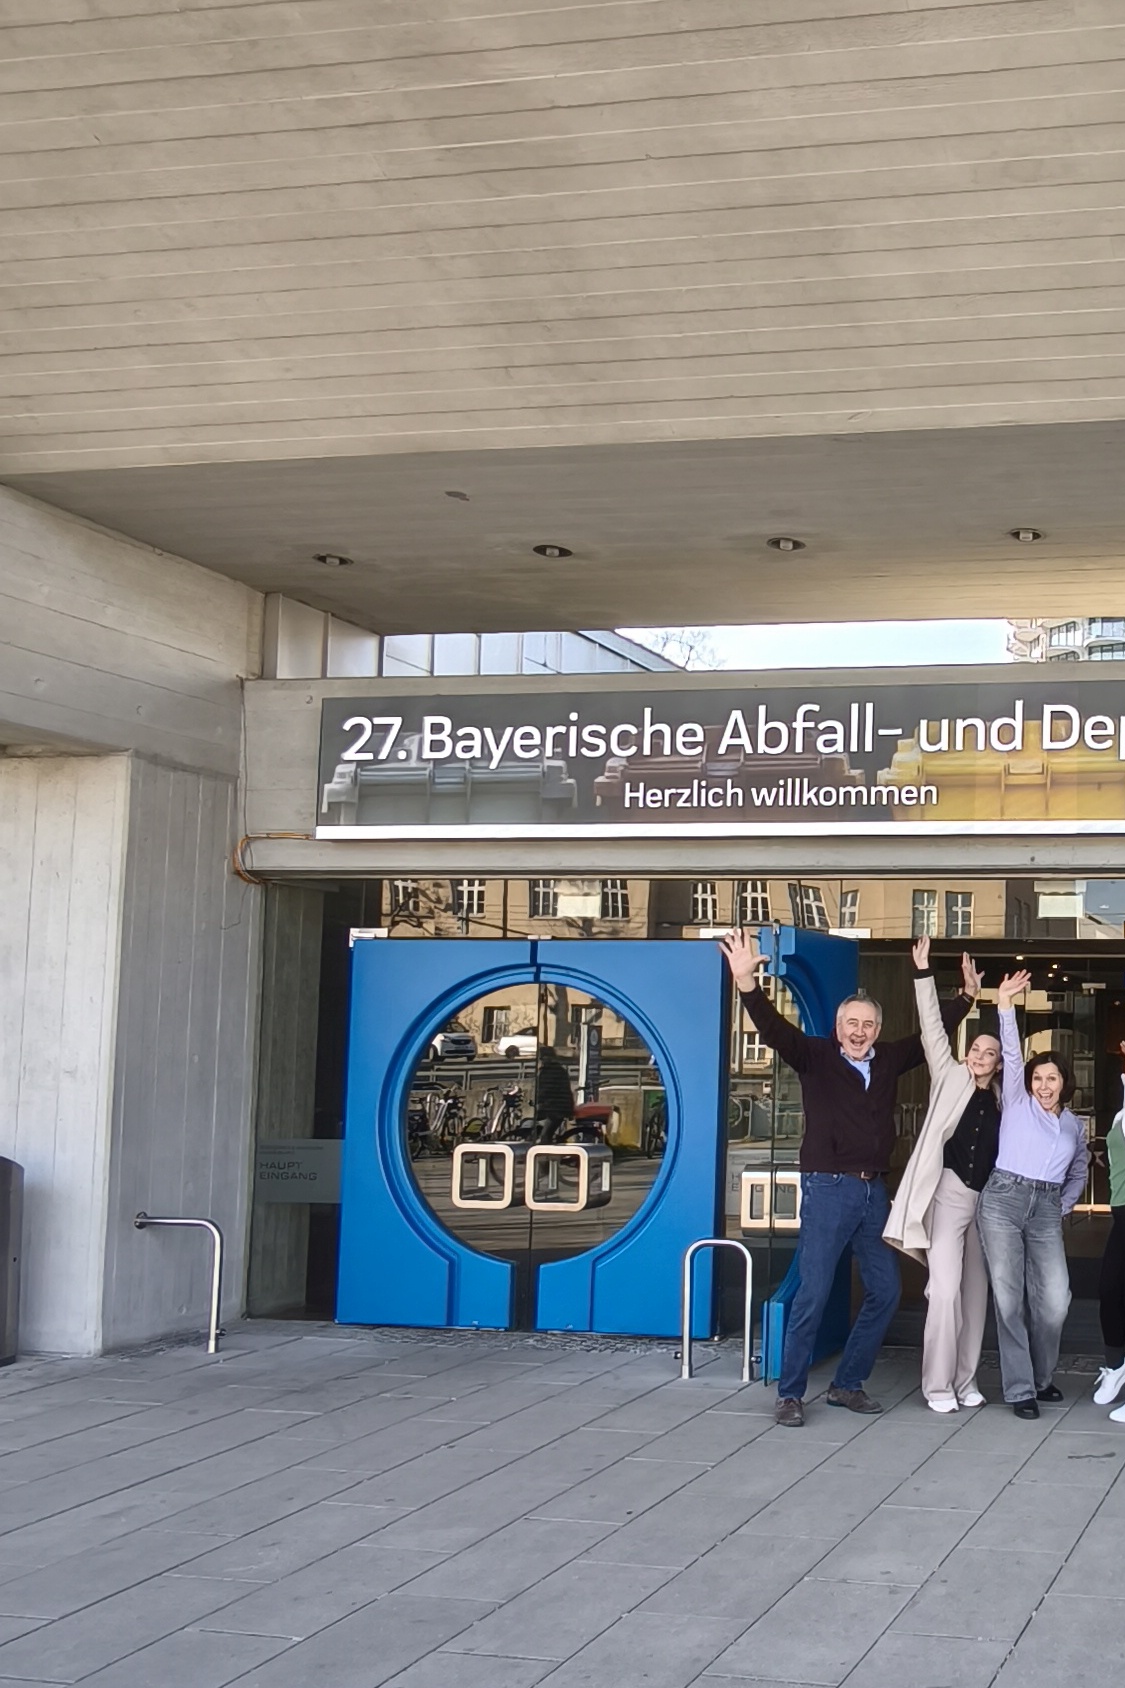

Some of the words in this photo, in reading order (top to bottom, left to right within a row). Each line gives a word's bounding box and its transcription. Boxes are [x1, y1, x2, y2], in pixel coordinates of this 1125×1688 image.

[341, 716, 408, 761] 27.
[421, 707, 704, 770] Bayerische
[918, 700, 1024, 752] und
[624, 778, 743, 809] Herzlich
[750, 777, 938, 807] willkommen
[260, 1161, 302, 1170] HAUPT
[260, 1171, 317, 1181] EINGANG
